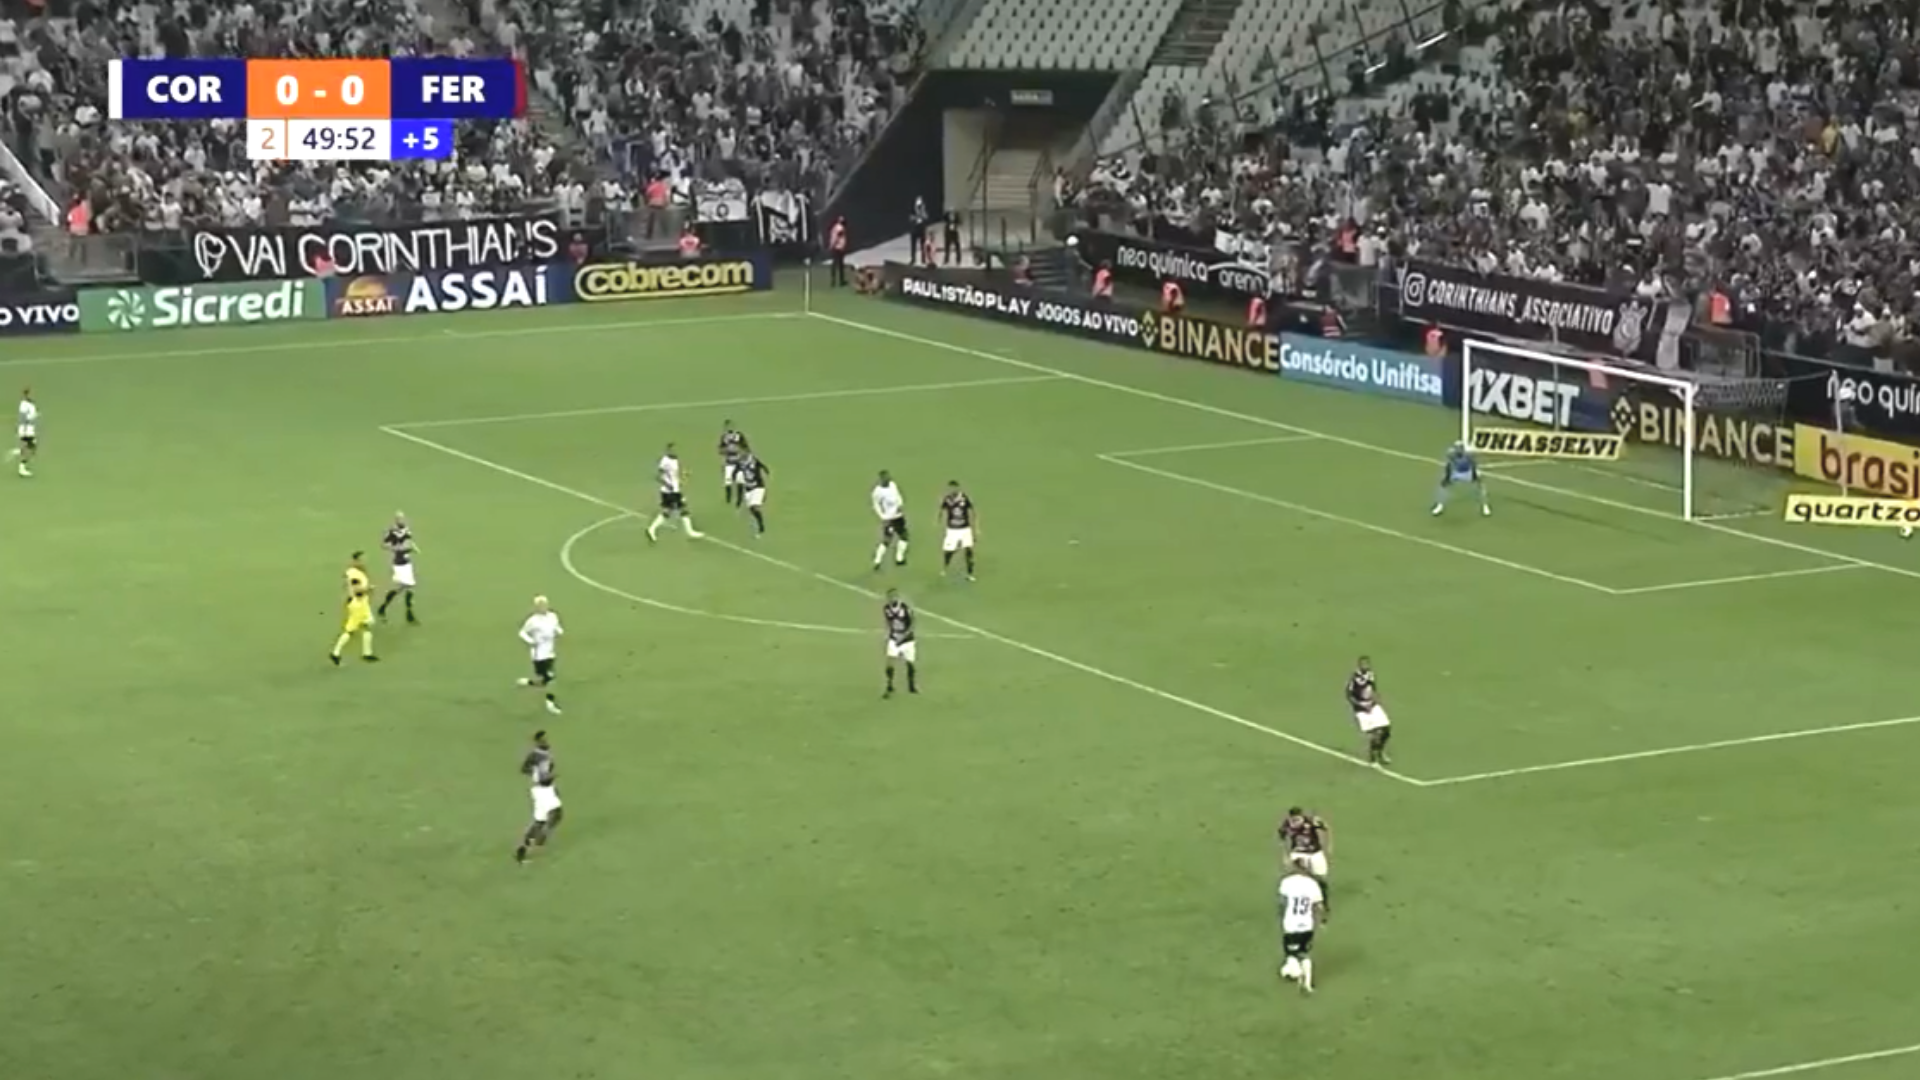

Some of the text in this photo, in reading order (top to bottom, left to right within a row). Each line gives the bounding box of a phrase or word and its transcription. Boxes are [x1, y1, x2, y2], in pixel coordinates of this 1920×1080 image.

[226, 220, 558, 277] VAI CORINTHIANS
[1117, 245, 1208, 282] neo química
[586, 260, 754, 294] cobrecom
[16, 304, 80, 325] VIVO
[153, 281, 304, 326] Sicredi
[1035, 302, 1081, 327] JOGOS
[1082, 311, 1102, 329] AO
[1104, 313, 1139, 337] VIVO
[1160, 315, 1280, 371] BINANCE
[1280, 343, 1443, 396] Consórcio Unifisa
[1474, 430, 1620, 458] UNIASSELVI
[1640, 401, 1793, 468] BINANCE
[1820, 434, 1920, 500] brasi
[1793, 501, 1920, 522] quartzo
[1292, 897, 1310, 915] 19
